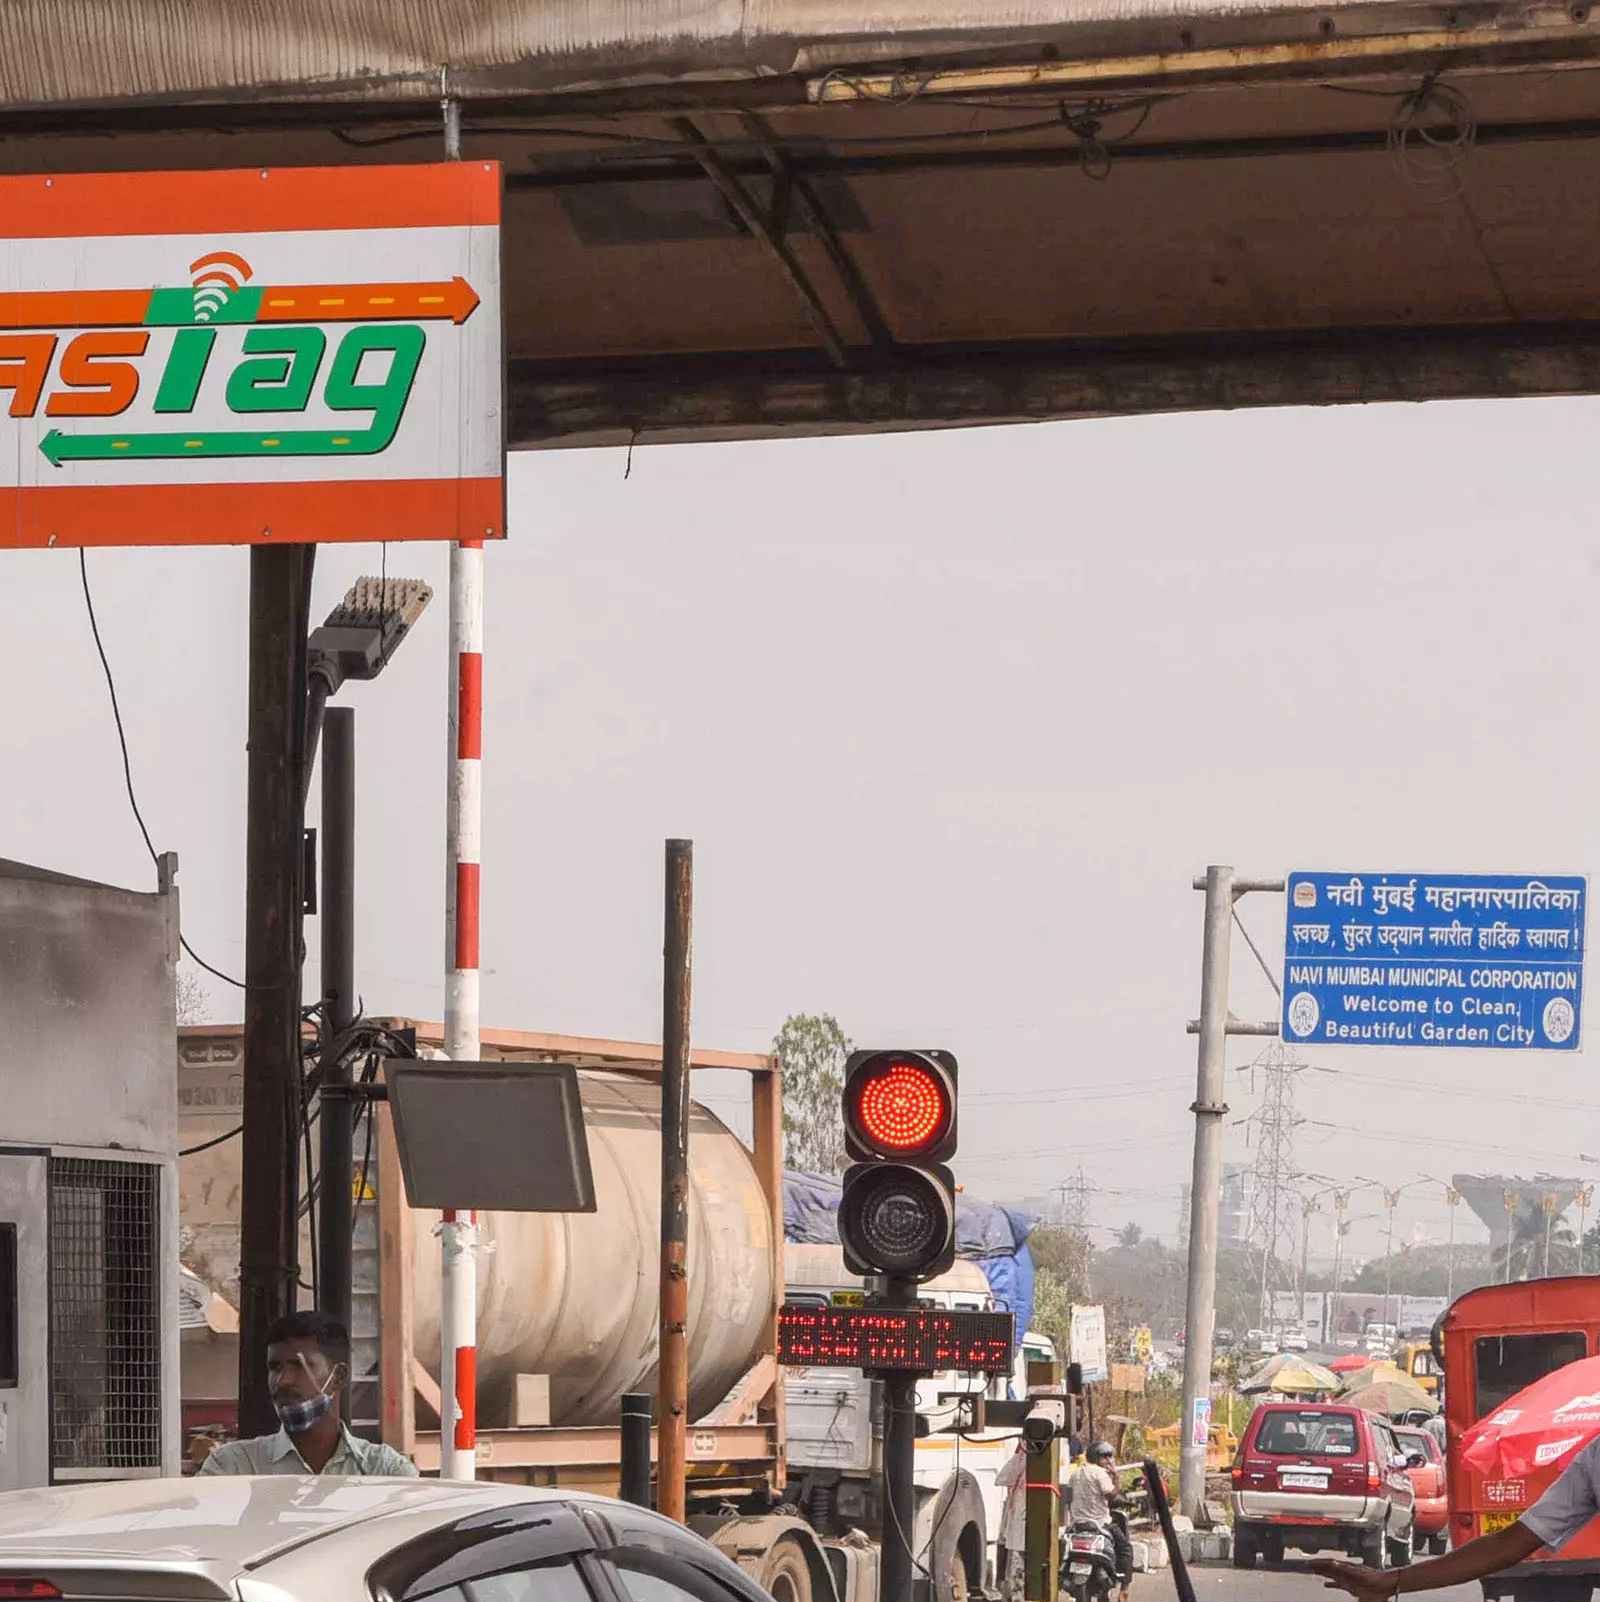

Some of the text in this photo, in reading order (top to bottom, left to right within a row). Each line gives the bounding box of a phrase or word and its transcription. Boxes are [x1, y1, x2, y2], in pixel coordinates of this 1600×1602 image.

[1327, 877, 1580, 914] नवी मुंबई महानगरपालिका
[1342, 917, 1372, 951] सुंदर
[1429, 919, 1473, 946] नगरीत
[1478, 922, 1520, 950] हार्दिक
[1290, 966, 1577, 990] NAVI MUMBAI MUNICIPAL CORPORATION
[1343, 995, 1428, 1013] Welcome
[1434, 997, 1453, 1014] to
[1325, 1021, 1414, 1039] Beautiful
[1421, 1022, 1488, 1041] Garden
